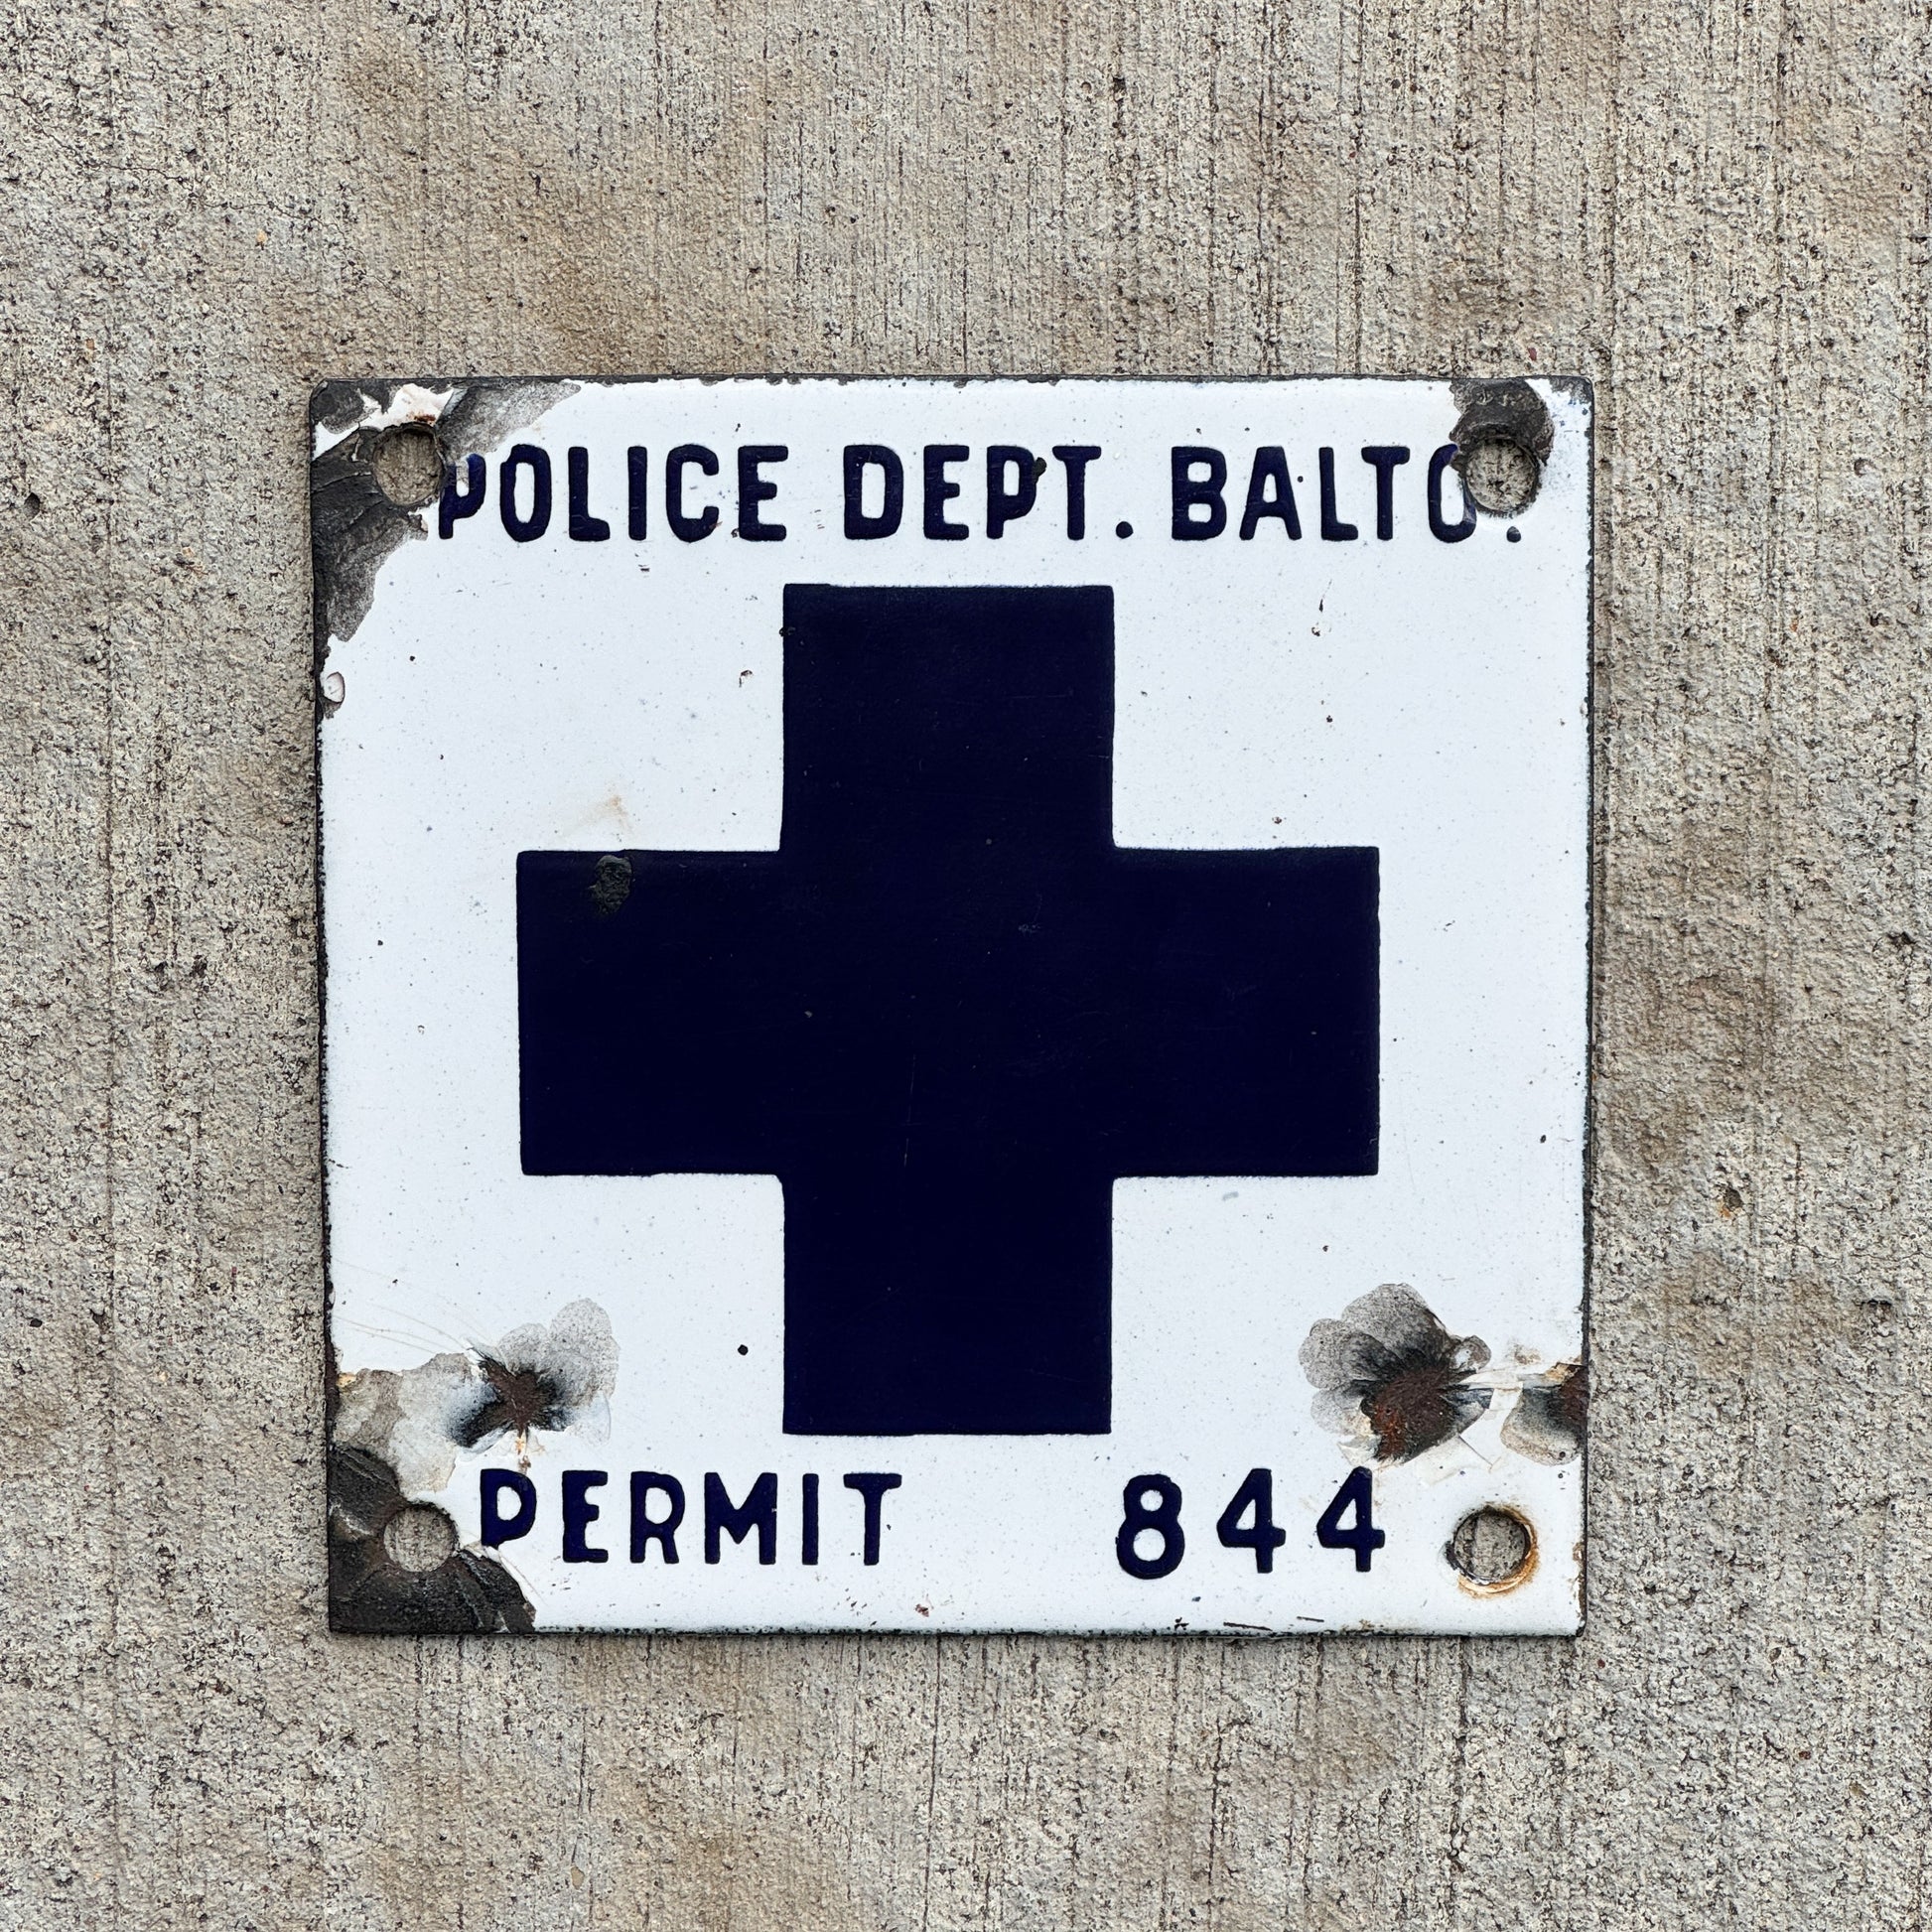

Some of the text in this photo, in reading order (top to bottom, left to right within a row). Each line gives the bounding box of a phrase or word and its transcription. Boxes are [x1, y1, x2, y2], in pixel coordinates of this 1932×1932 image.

[438, 443, 1522, 544] POLICE DEPT. BALTO.
[480, 1465, 1386, 1580] PERMIT 844
